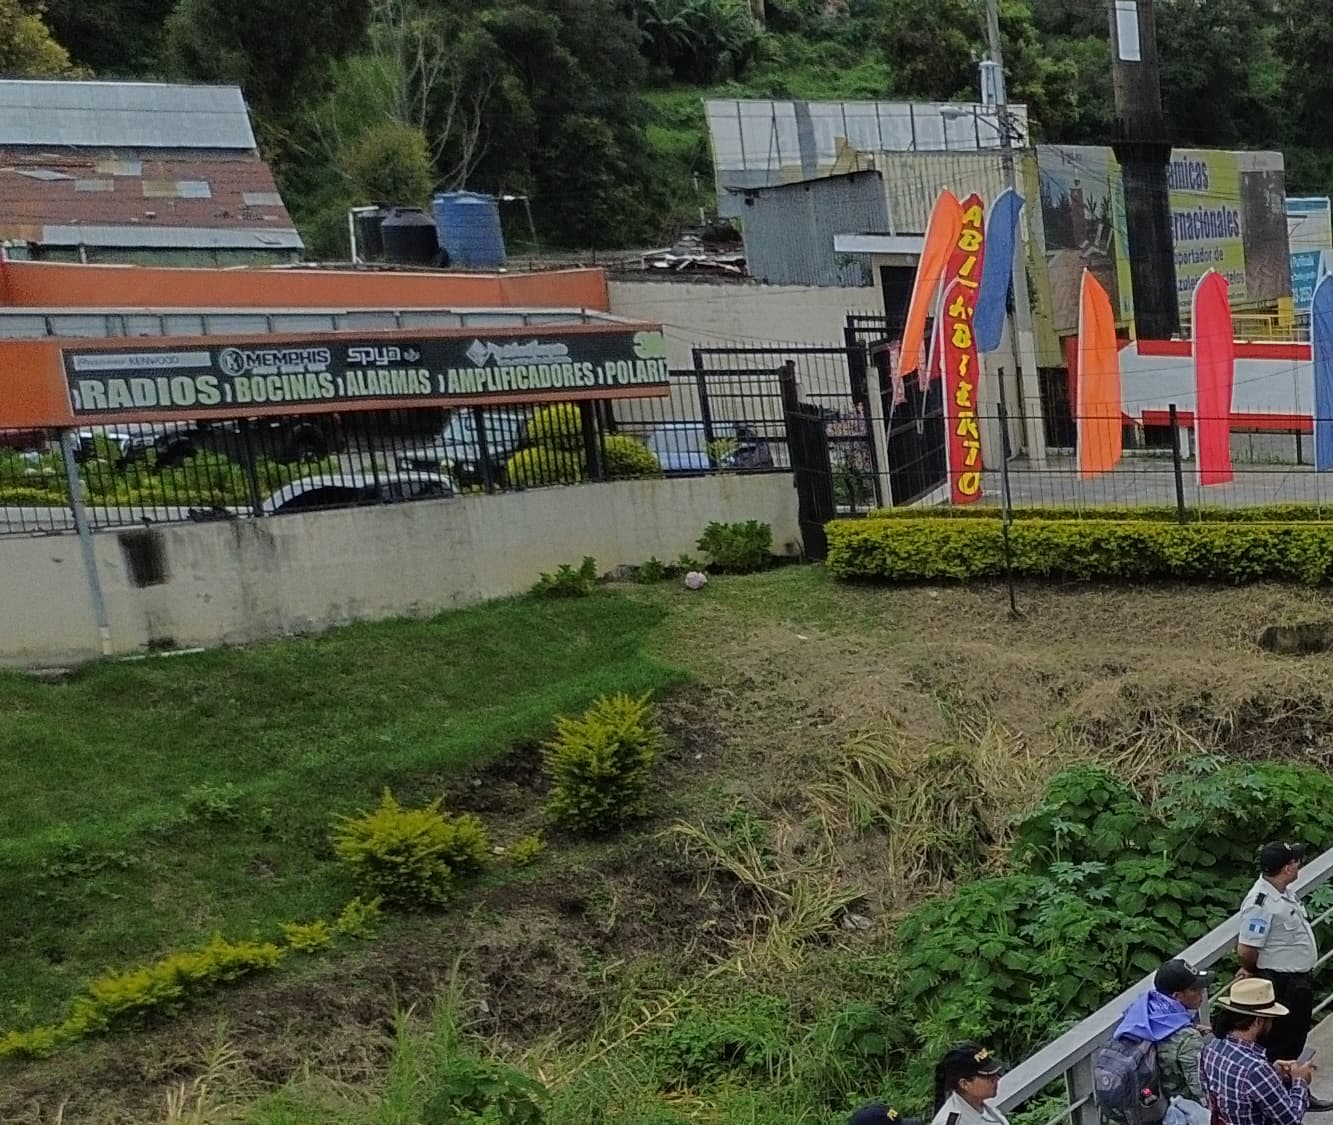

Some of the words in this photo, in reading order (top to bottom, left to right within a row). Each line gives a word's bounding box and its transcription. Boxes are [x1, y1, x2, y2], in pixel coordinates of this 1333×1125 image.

[246, 350, 330, 366] MEMPHIS
[79, 376, 221, 410] RADIOS
[234, 371, 336, 401] BOCINAS
[346, 368, 432, 397] ALARMAS
[448, 361, 594, 394] AMPLIFICADORES
